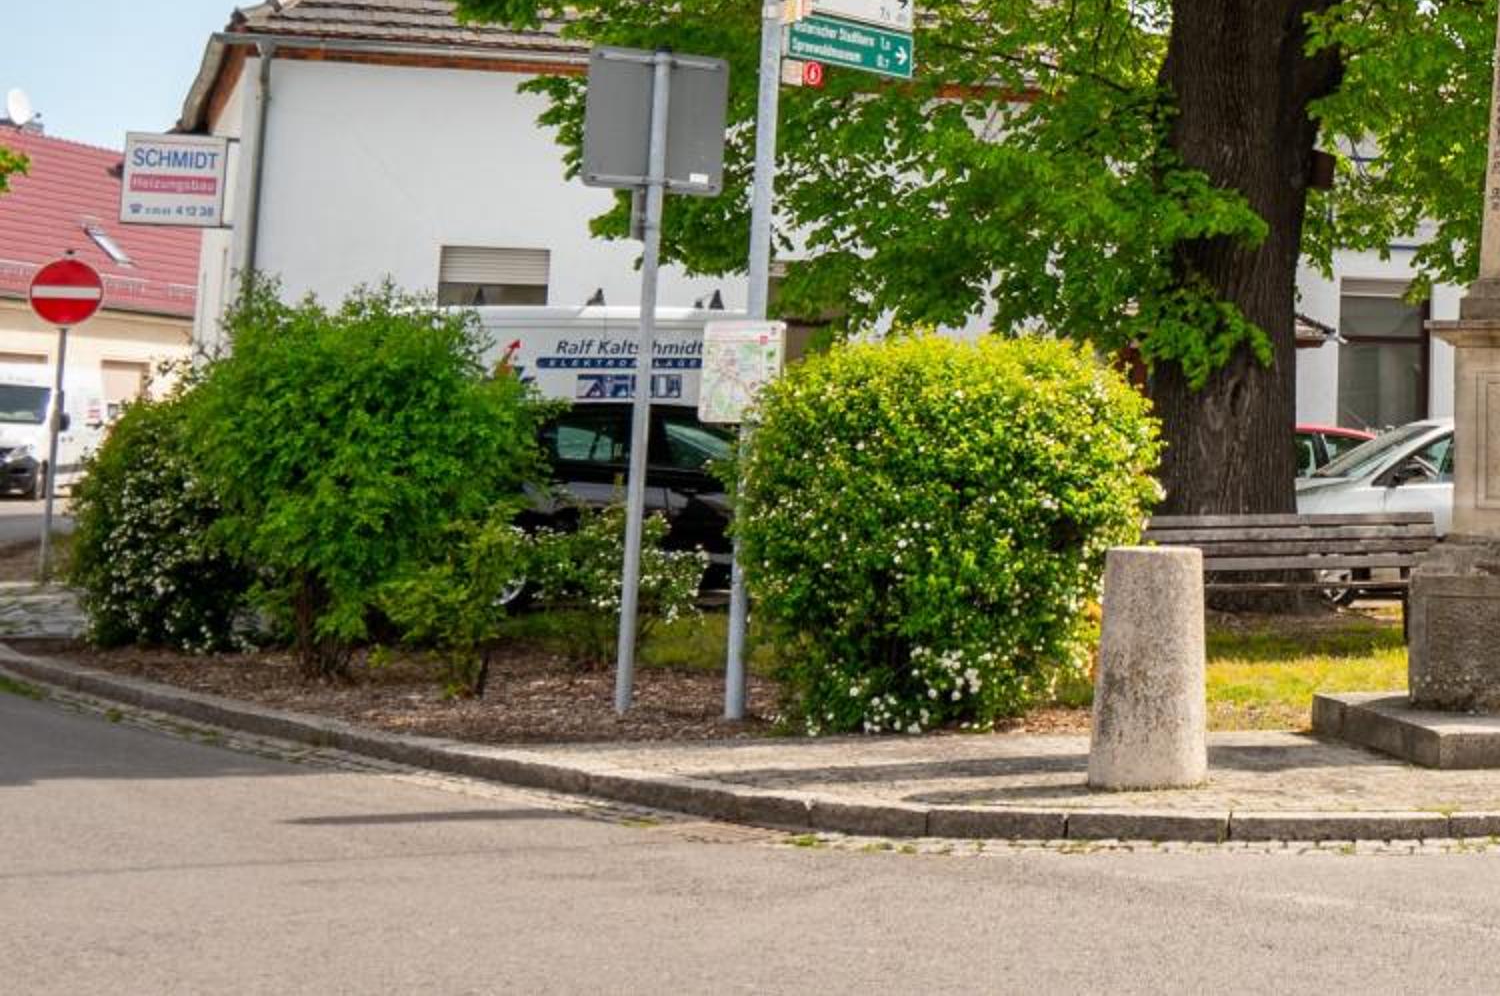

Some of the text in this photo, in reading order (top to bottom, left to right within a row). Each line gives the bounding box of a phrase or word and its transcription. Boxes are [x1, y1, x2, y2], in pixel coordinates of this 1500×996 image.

[132, 148, 219, 169] SCHMIDT
[132, 176, 215, 192] Heizungsbau
[556, 339, 703, 356] Ralf Kaltshmidt
